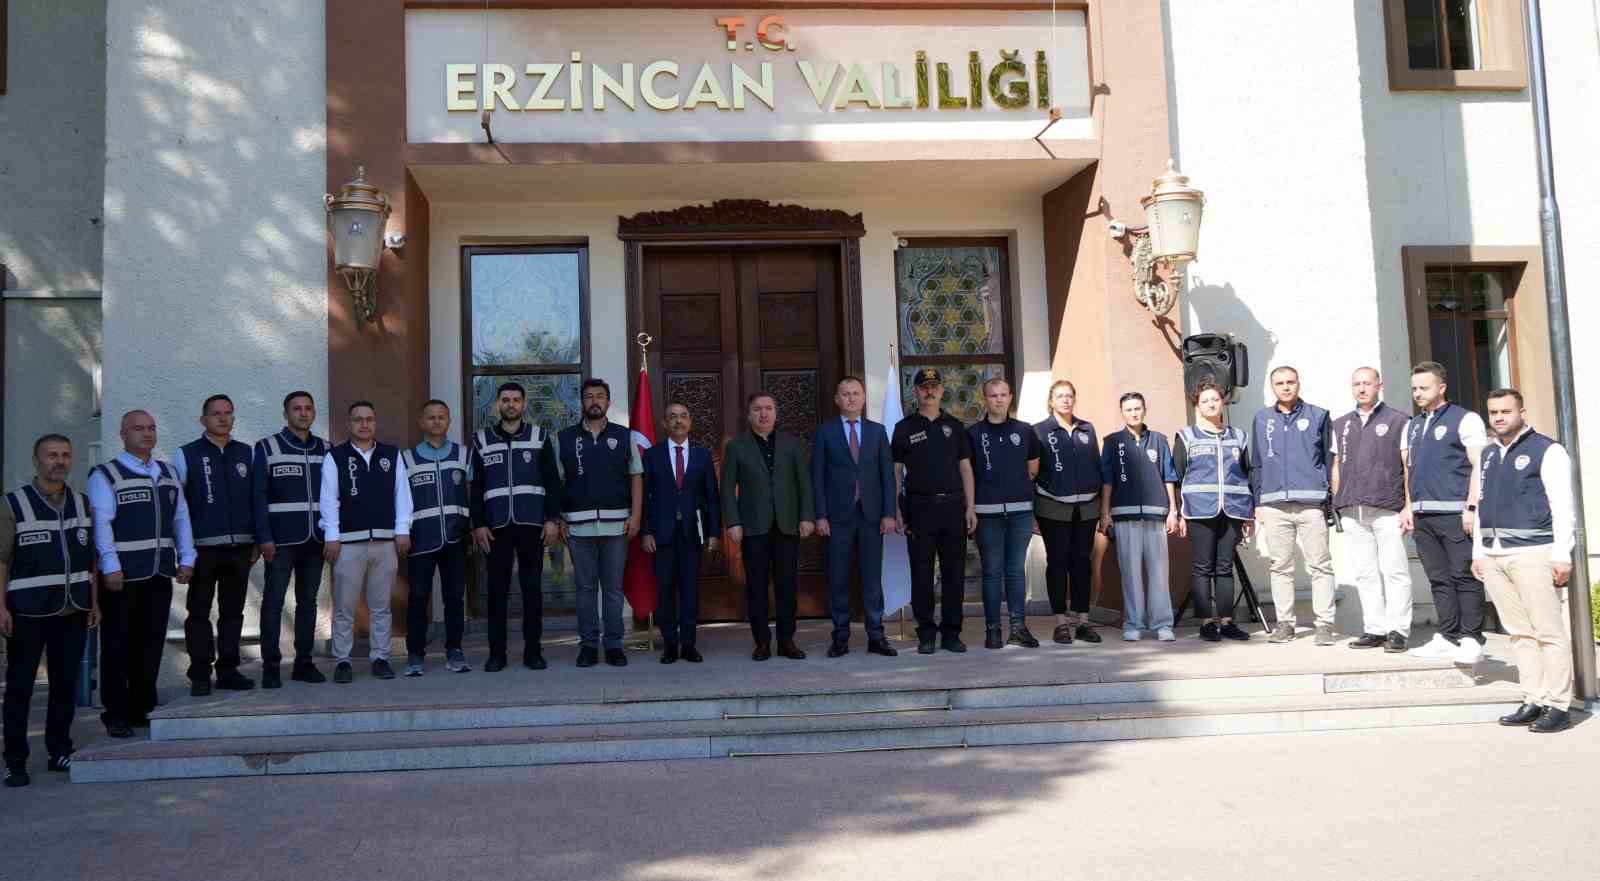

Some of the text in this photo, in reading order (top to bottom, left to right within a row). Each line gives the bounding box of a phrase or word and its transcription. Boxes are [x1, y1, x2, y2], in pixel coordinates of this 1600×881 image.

[715, 15, 796, 51] T.C.
[446, 49, 1050, 112] ERZİNCAN VALİLİĞİ
